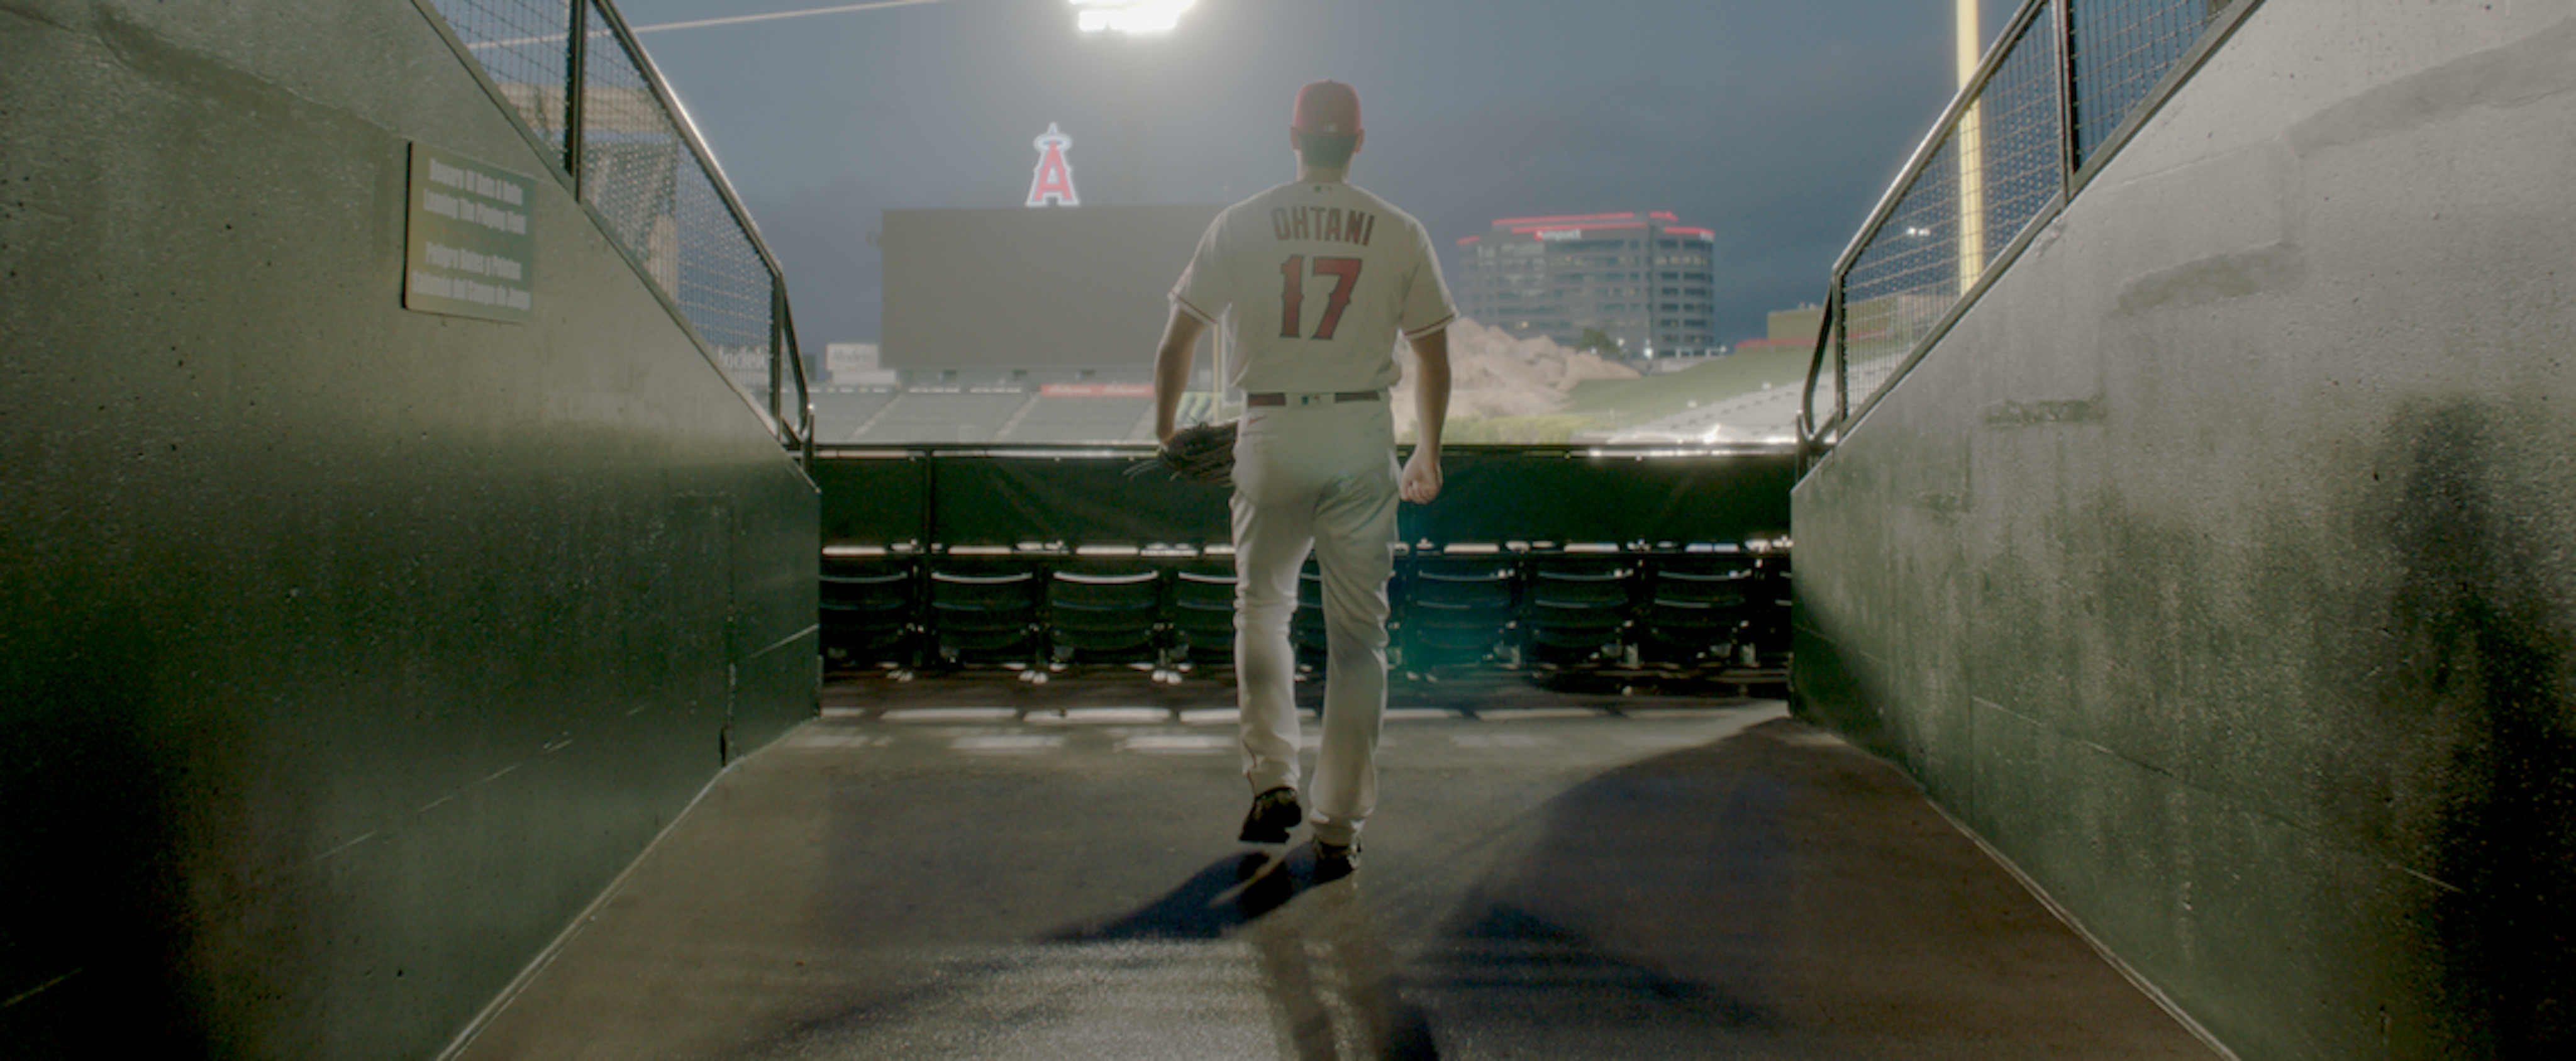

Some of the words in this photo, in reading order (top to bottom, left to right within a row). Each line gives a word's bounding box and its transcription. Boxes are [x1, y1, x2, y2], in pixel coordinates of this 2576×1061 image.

[1025, 122, 1080, 206] A
[1270, 206, 1375, 247] OHTANI
[1279, 254, 1363, 340] 17
